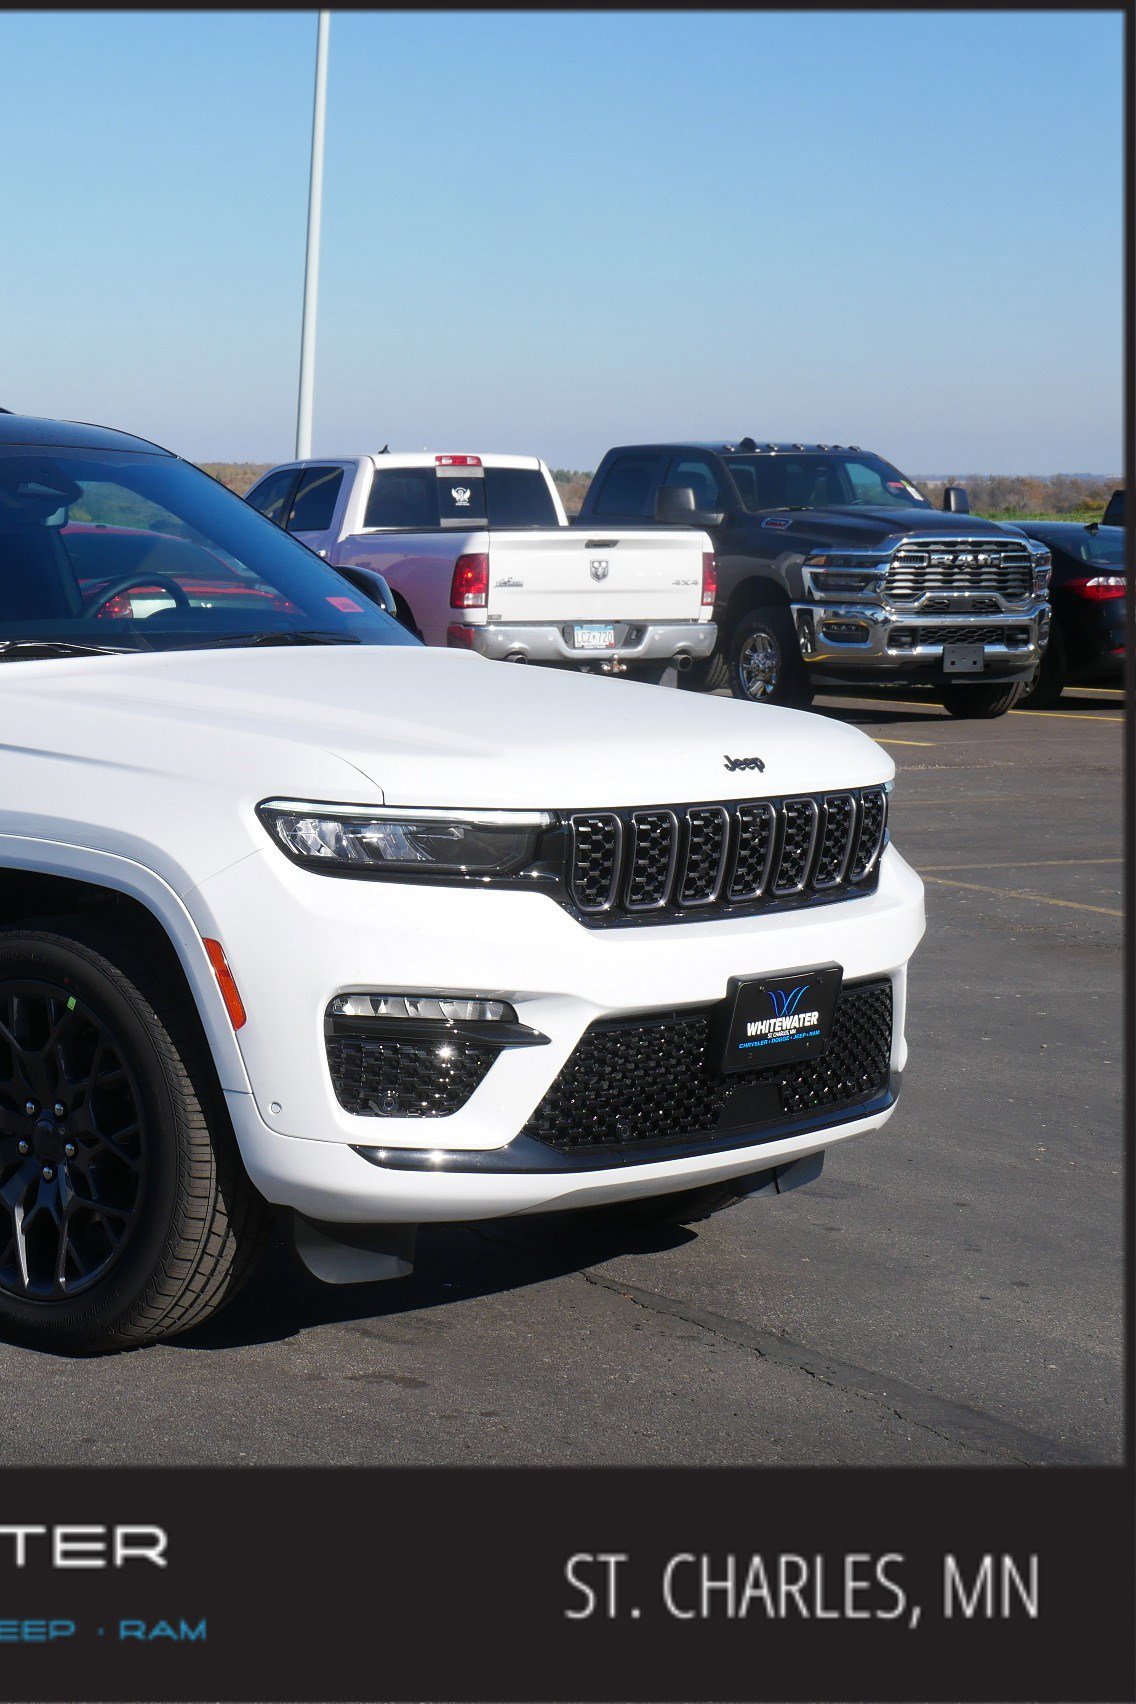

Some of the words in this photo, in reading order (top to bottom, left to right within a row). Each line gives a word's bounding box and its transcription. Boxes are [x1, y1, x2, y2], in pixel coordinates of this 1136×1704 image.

[723, 754, 766, 774] Jeep
[747, 1011, 819, 1036] WHITEWATER
[739, 1040, 768, 1048] CHRYSLER
